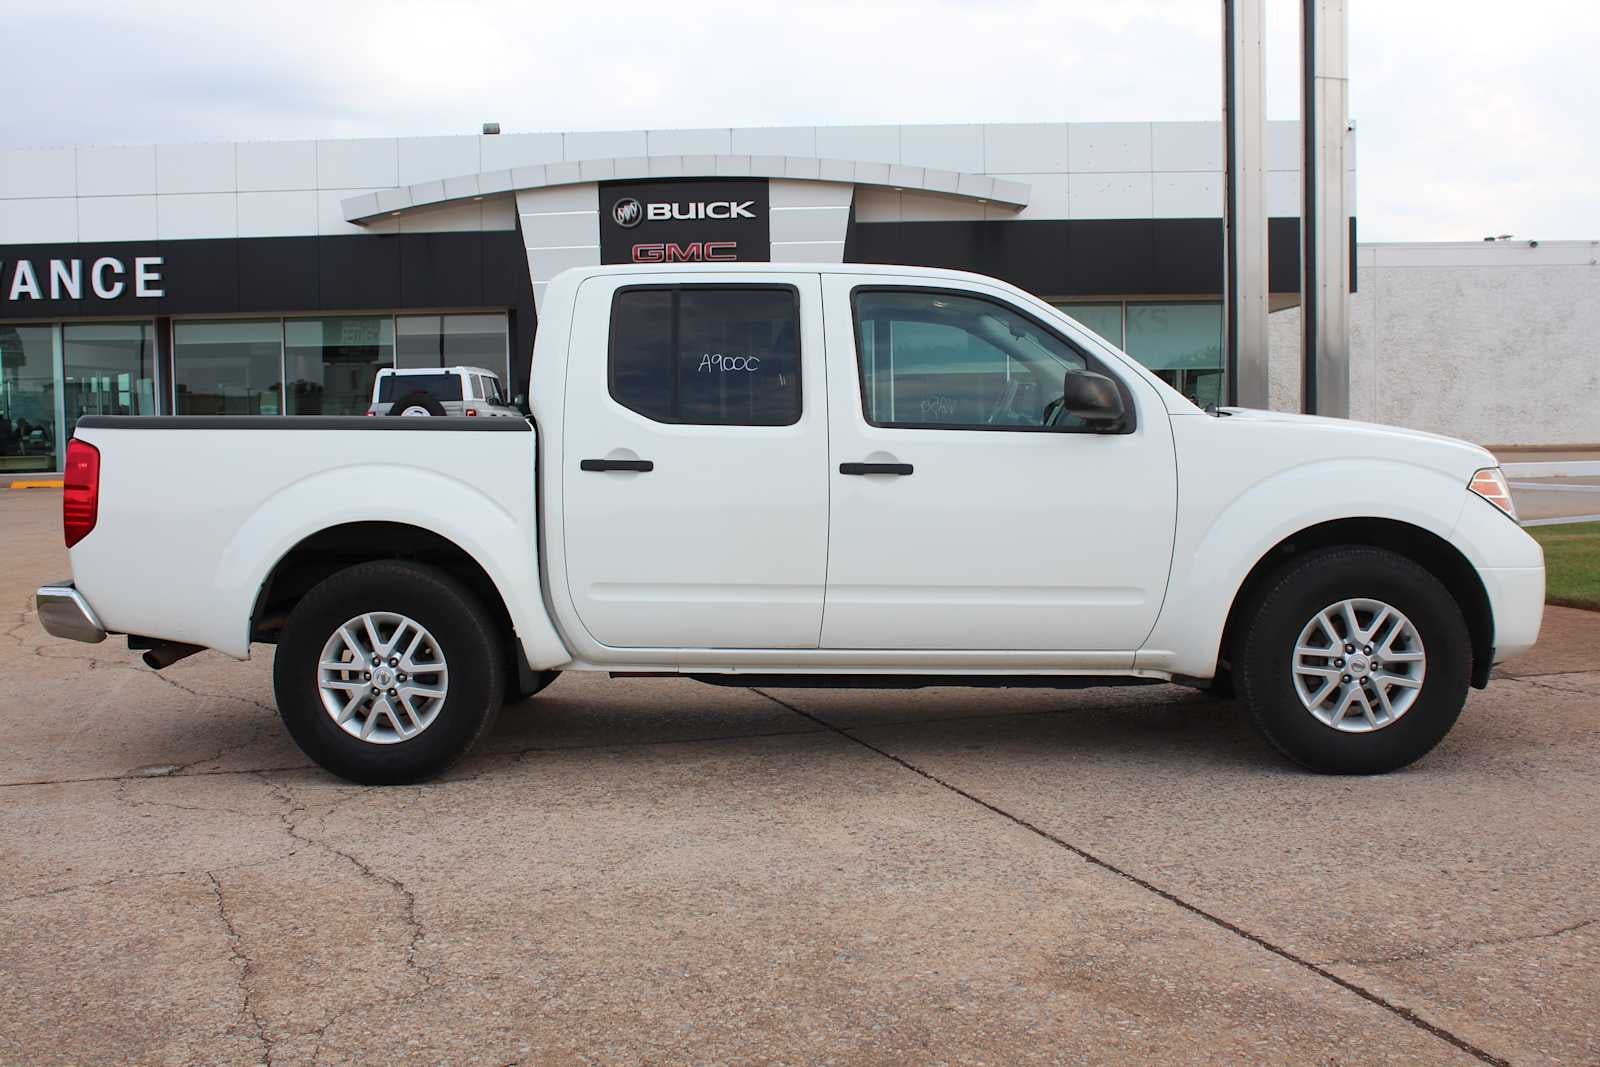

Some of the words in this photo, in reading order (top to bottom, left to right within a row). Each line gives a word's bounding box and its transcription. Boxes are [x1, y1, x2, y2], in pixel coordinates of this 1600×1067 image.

[647, 201, 756, 220] BUICK
[632, 242, 736, 263] GMC
[0, 257, 164, 300] ANCE
